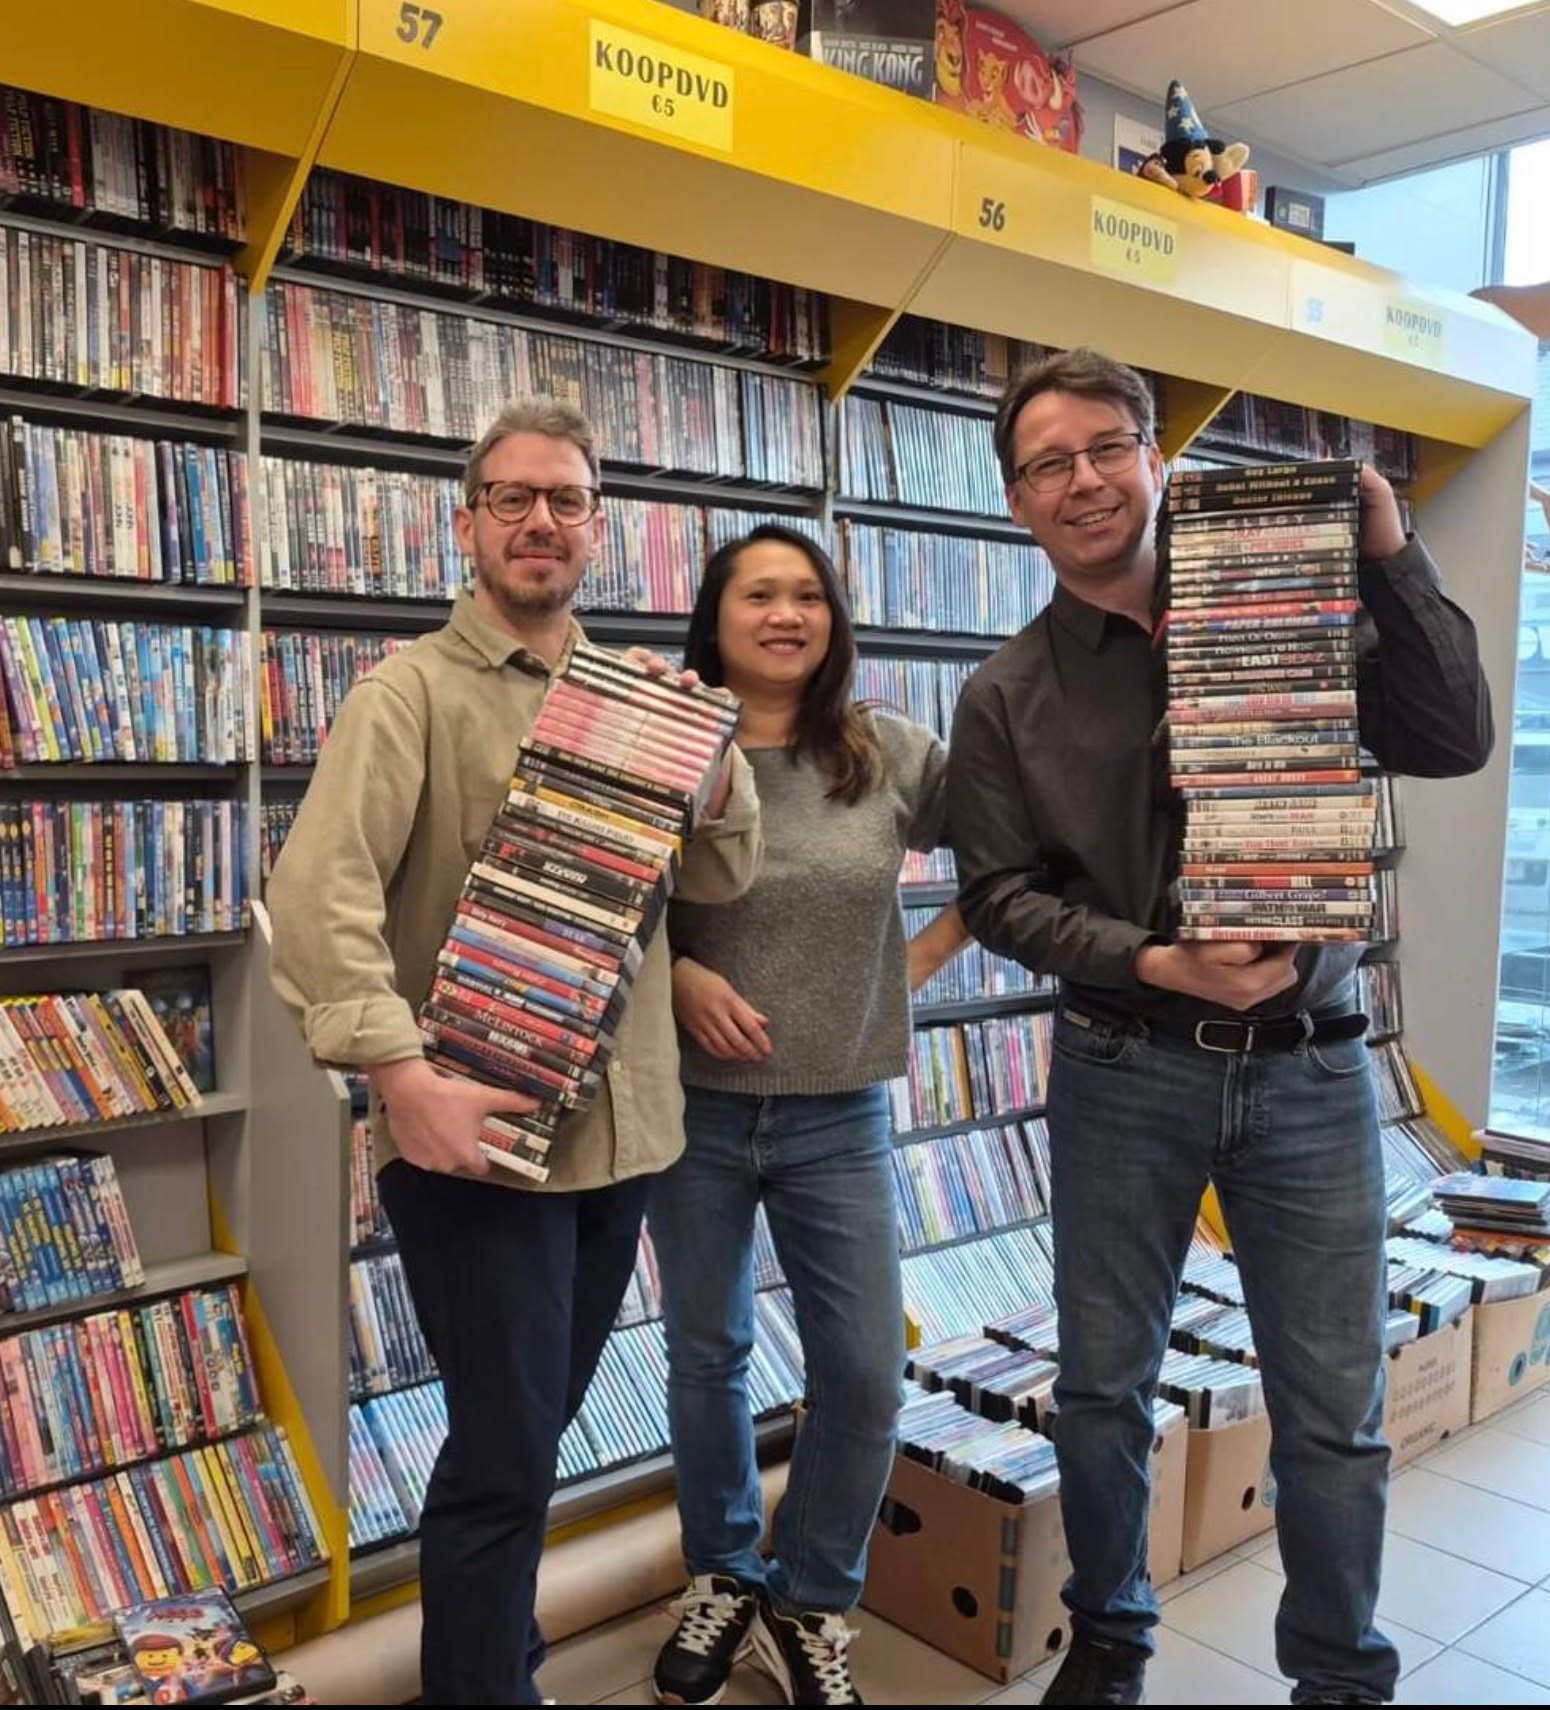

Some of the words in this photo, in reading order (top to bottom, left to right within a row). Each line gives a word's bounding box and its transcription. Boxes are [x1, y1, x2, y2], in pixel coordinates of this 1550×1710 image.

[395, 3, 443, 49] 57
[594, 39, 729, 109] KOOPDVD
[822, 46, 869, 78] KING
[872, 51, 924, 89] KONG
[651, 94, 676, 118] €5
[978, 198, 1005, 232] 56
[1093, 209, 1174, 256] KOOPDVD
[1386, 304, 1444, 338] KOOPDVD
